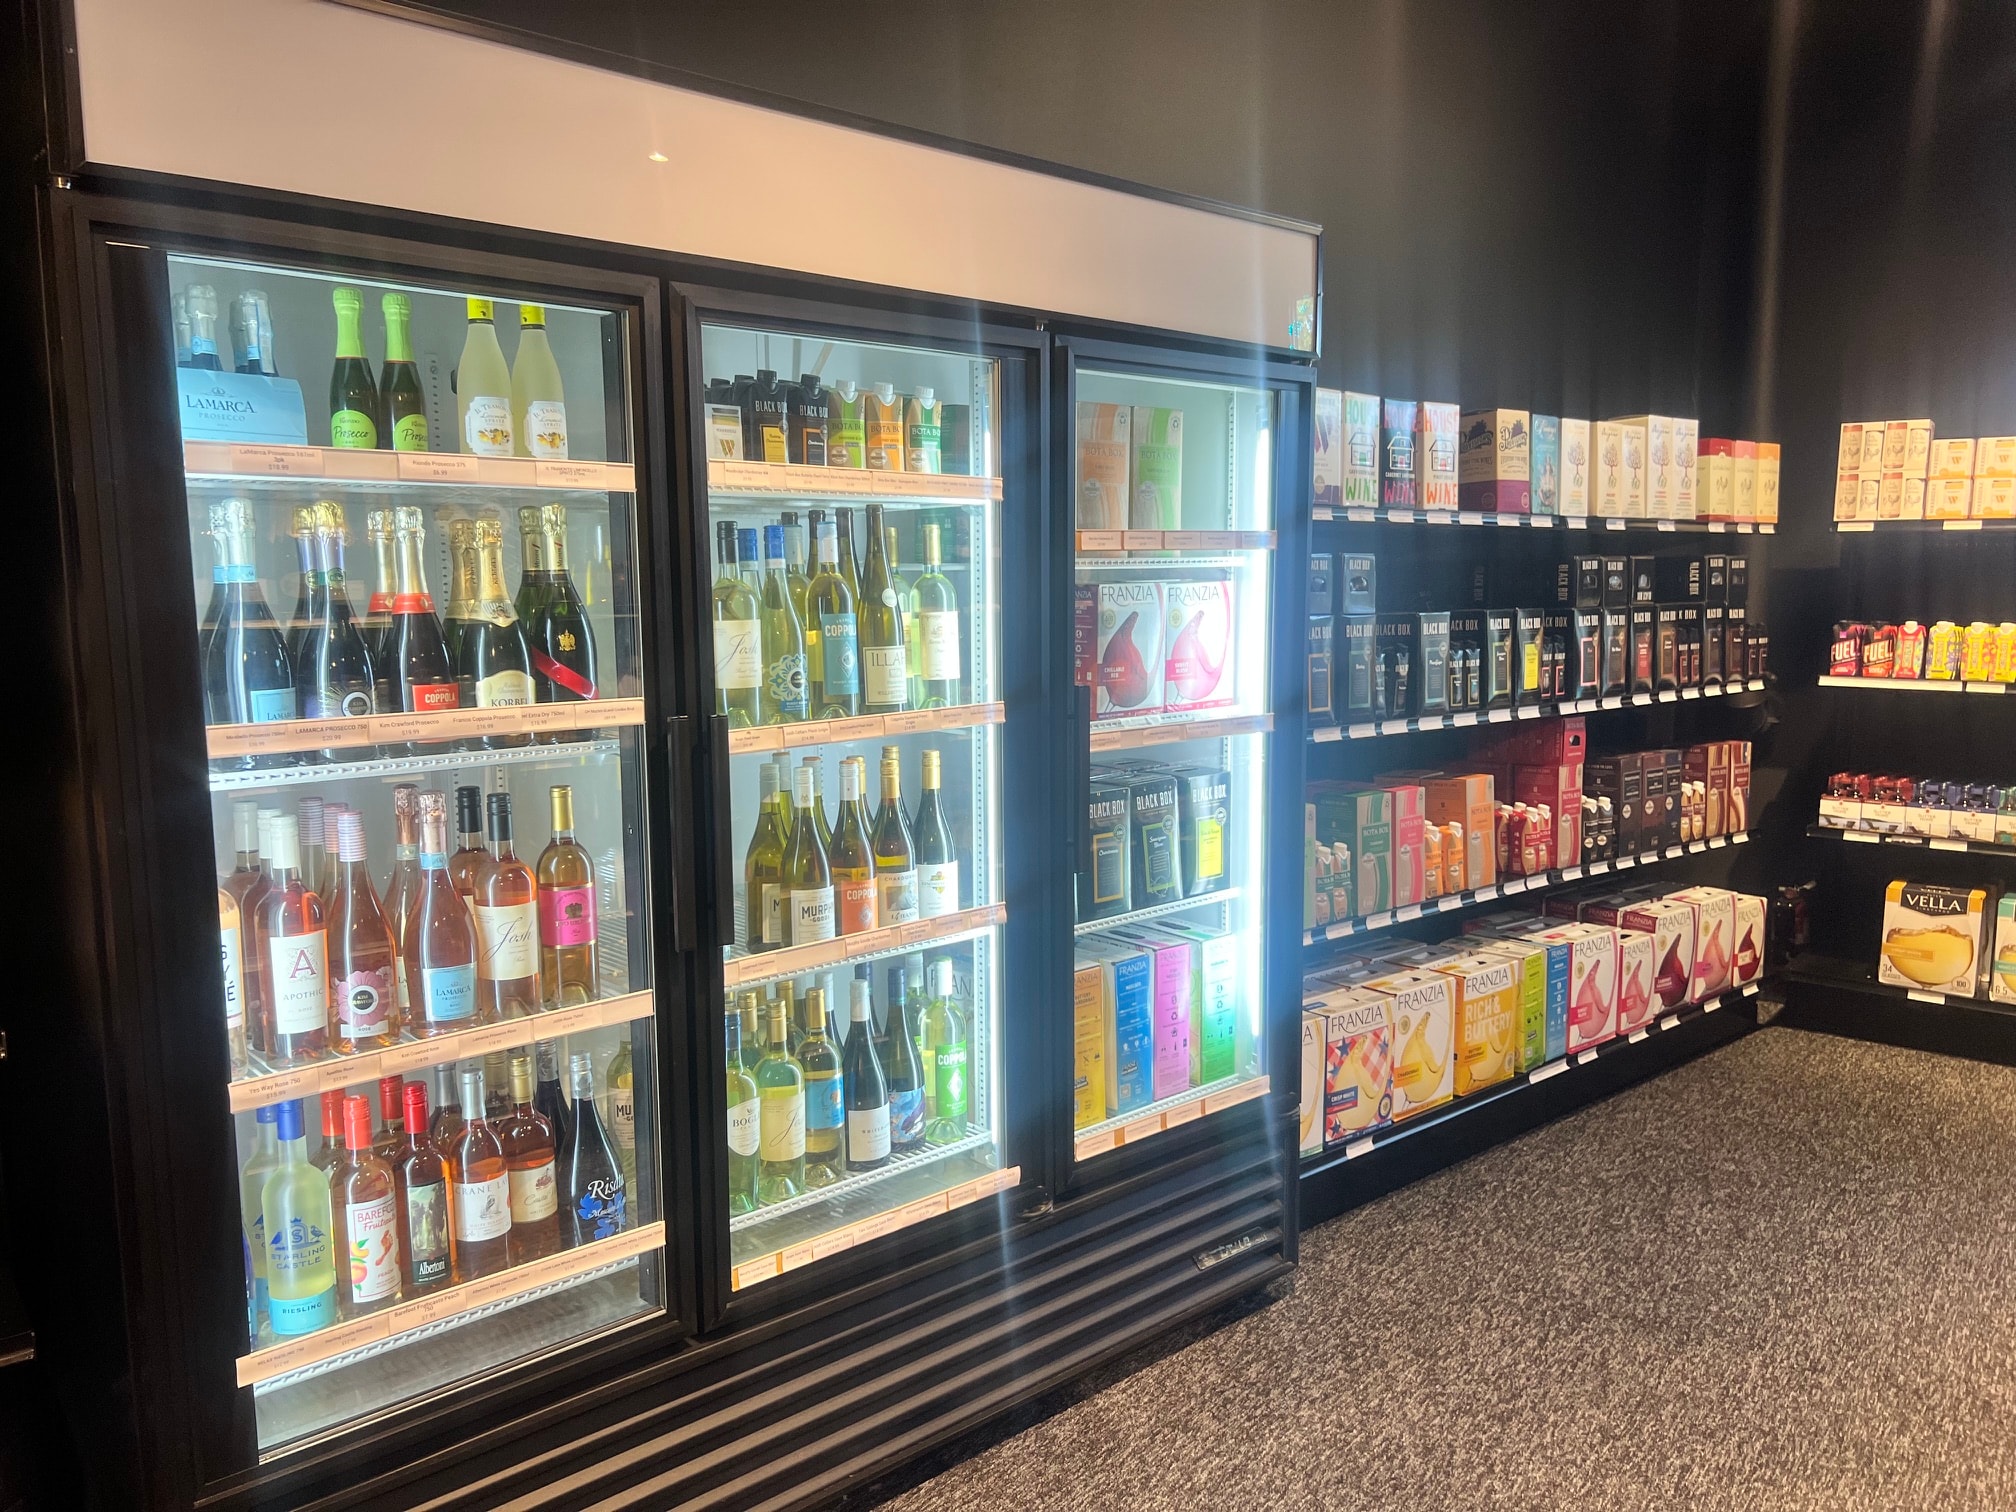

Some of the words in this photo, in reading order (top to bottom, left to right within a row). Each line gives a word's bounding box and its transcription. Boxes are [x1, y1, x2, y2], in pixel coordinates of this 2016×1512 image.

[186, 394, 255, 414] LAMARCA
[756, 400, 776, 412] BLACK
[800, 405, 817, 417] BLACK
[199, 412, 246, 422] PROSECCO
[333, 425, 370, 440] Prosecco
[832, 422, 852, 432] BOTA
[853, 424, 862, 432] BO
[871, 425, 891, 434] BOTA
[892, 425, 901, 433] BO
[912, 428, 931, 436] BOTA
[1085, 447, 1106, 457] BOTA
[1141, 451, 1161, 460] BOTA
[1345, 477, 1378, 503] WINE
[1385, 479, 1416, 505] WINE
[1426, 481, 1458, 506] WINE
[1350, 559, 1362, 571] BLACK
[1362, 559, 1371, 571] BOX
[1101, 585, 1155, 607] FRANZIA
[1168, 586, 1220, 606] FRANZIA
[1578, 615, 1591, 627] BLACK
[1591, 614, 1599, 626] BOX
[1606, 614, 1618, 627] BLACK
[1618, 614, 1626, 626] BOX
[1634, 612, 1645, 623] BLACK
[1660, 611, 1670, 622] BLACK
[1684, 609, 1697, 620] BOX
[1346, 624, 1362, 637] BLACK
[1363, 624, 1373, 636] BOX
[1376, 623, 1396, 637] BLACK
[1397, 623, 1411, 636] BOX
[1423, 622, 1437, 635] BLACK
[1438, 621, 1448, 634] BOX
[1465, 619, 1479, 631] BOX
[1490, 618, 1502, 630] BLACK
[1502, 617, 1511, 630] BOX
[1520, 617, 1532, 630] BLACK
[717, 631, 760, 672] Josh
[424, 692, 455, 703] COPPOLA
[390, 720, 415, 728] Crawford
[415, 718, 439, 726] Prosecco
[472, 715, 493, 724] Coppola
[295, 727, 325, 736] LAMARCA
[325, 725, 356, 733] PROSECCO
[1192, 786, 1213, 803] BLACK
[1213, 783, 1227, 798] BOX
[1136, 793, 1159, 811] BLACK
[1159, 790, 1173, 806] BOX
[1090, 802, 1111, 819] BLACK
[1112, 799, 1125, 816] BOX
[1363, 827, 1378, 836] BOTA
[1379, 825, 1389, 835] BOX
[1701, 899, 1731, 917] FRANZIA
[1906, 894, 1961, 912] VELLA
[1626, 913, 1653, 926] FRANZIA
[1658, 911, 1691, 932] FRANZIA
[1737, 908, 1762, 922] FRANZIA
[482, 915, 535, 962] Josh
[1551, 947, 1568, 958] FRANZIA
[1574, 934, 1612, 958] FRANZIA
[1624, 940, 1650, 958] FRANZIA
[1119, 960, 1147, 976] FRANZIA
[1882, 963, 1893, 973] 34
[1465, 967, 1508, 996] FRANZIA
[283, 987, 324, 1002] APOTHIC
[435, 984, 472, 998] LAMARCA
[1398, 984, 1445, 1010] FRANZIA
[1464, 997, 1492, 1021] RICH
[1331, 1005, 1384, 1034] FRANZIA
[1464, 1010, 1512, 1042] BUTTERY
[249, 1087, 260, 1095] Yes
[261, 1083, 273, 1092] Way
[275, 1081, 289, 1089] Rose
[1331, 1093, 1343, 1103] CRISP
[455, 1183, 493, 1197] CRANE
[357, 1202, 395, 1223] BAREFO
[271, 1245, 326, 1261] STARLING
[276, 1256, 321, 1270] CASTLE
[418, 1258, 446, 1275] Albertoni
[281, 1302, 323, 1314] RIESLING
[394, 1306, 416, 1318] Barefoot
[444, 1291, 460, 1302] Peach
[424, 1305, 434, 1313] 750
